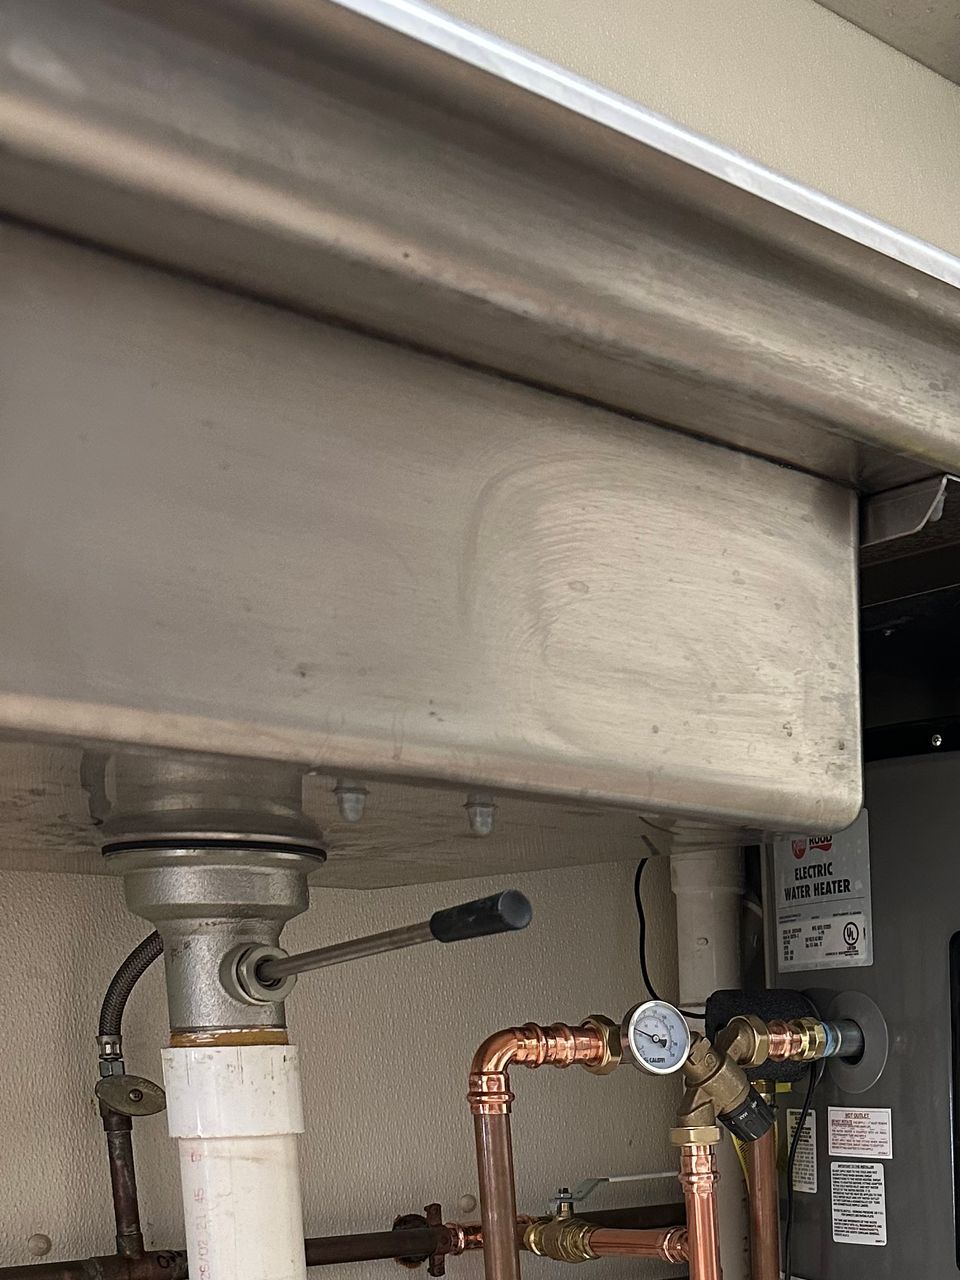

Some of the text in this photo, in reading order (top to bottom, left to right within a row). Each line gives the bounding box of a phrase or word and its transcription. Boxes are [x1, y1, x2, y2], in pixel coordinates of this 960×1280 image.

[794, 862, 834, 881] ELECTRIC
[784, 878, 851, 902] WATER HEATER
